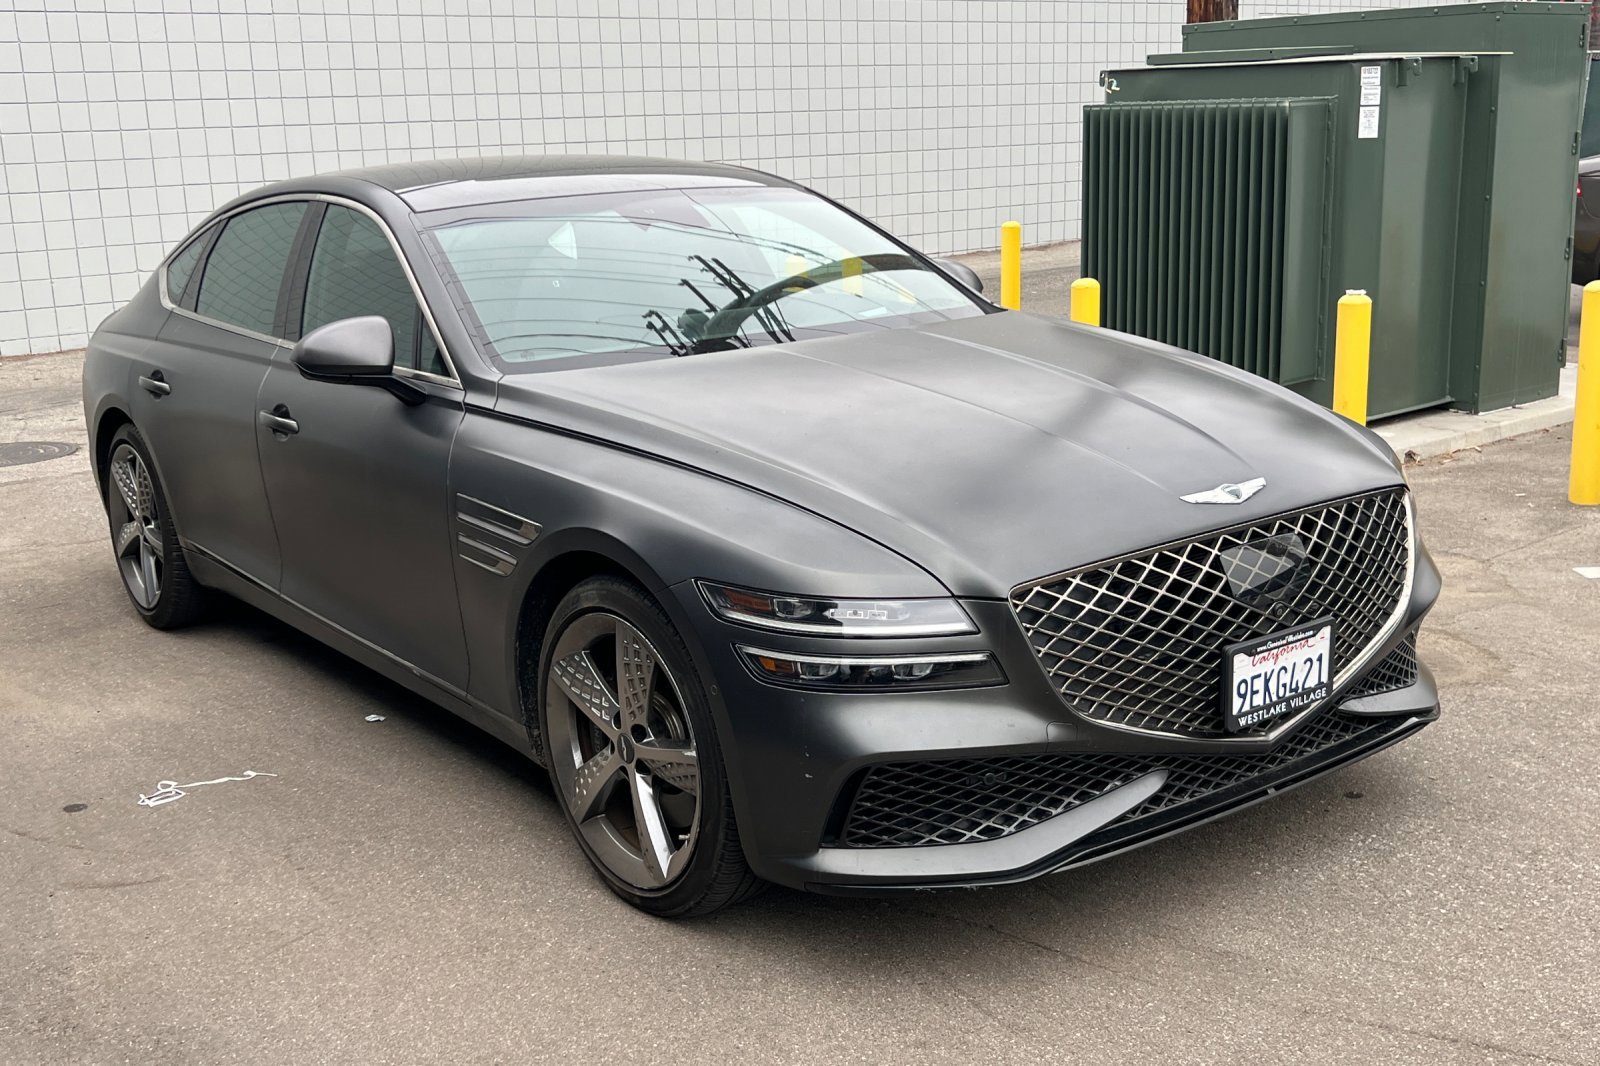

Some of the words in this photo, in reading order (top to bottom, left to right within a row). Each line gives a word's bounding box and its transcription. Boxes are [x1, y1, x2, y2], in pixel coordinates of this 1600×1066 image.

[1252, 639, 1316, 667] California
[1236, 652, 1325, 714] 9EKG421
[1238, 702, 1287, 727] WESTLAKE
[1290, 687, 1327, 709] VILLAGE
